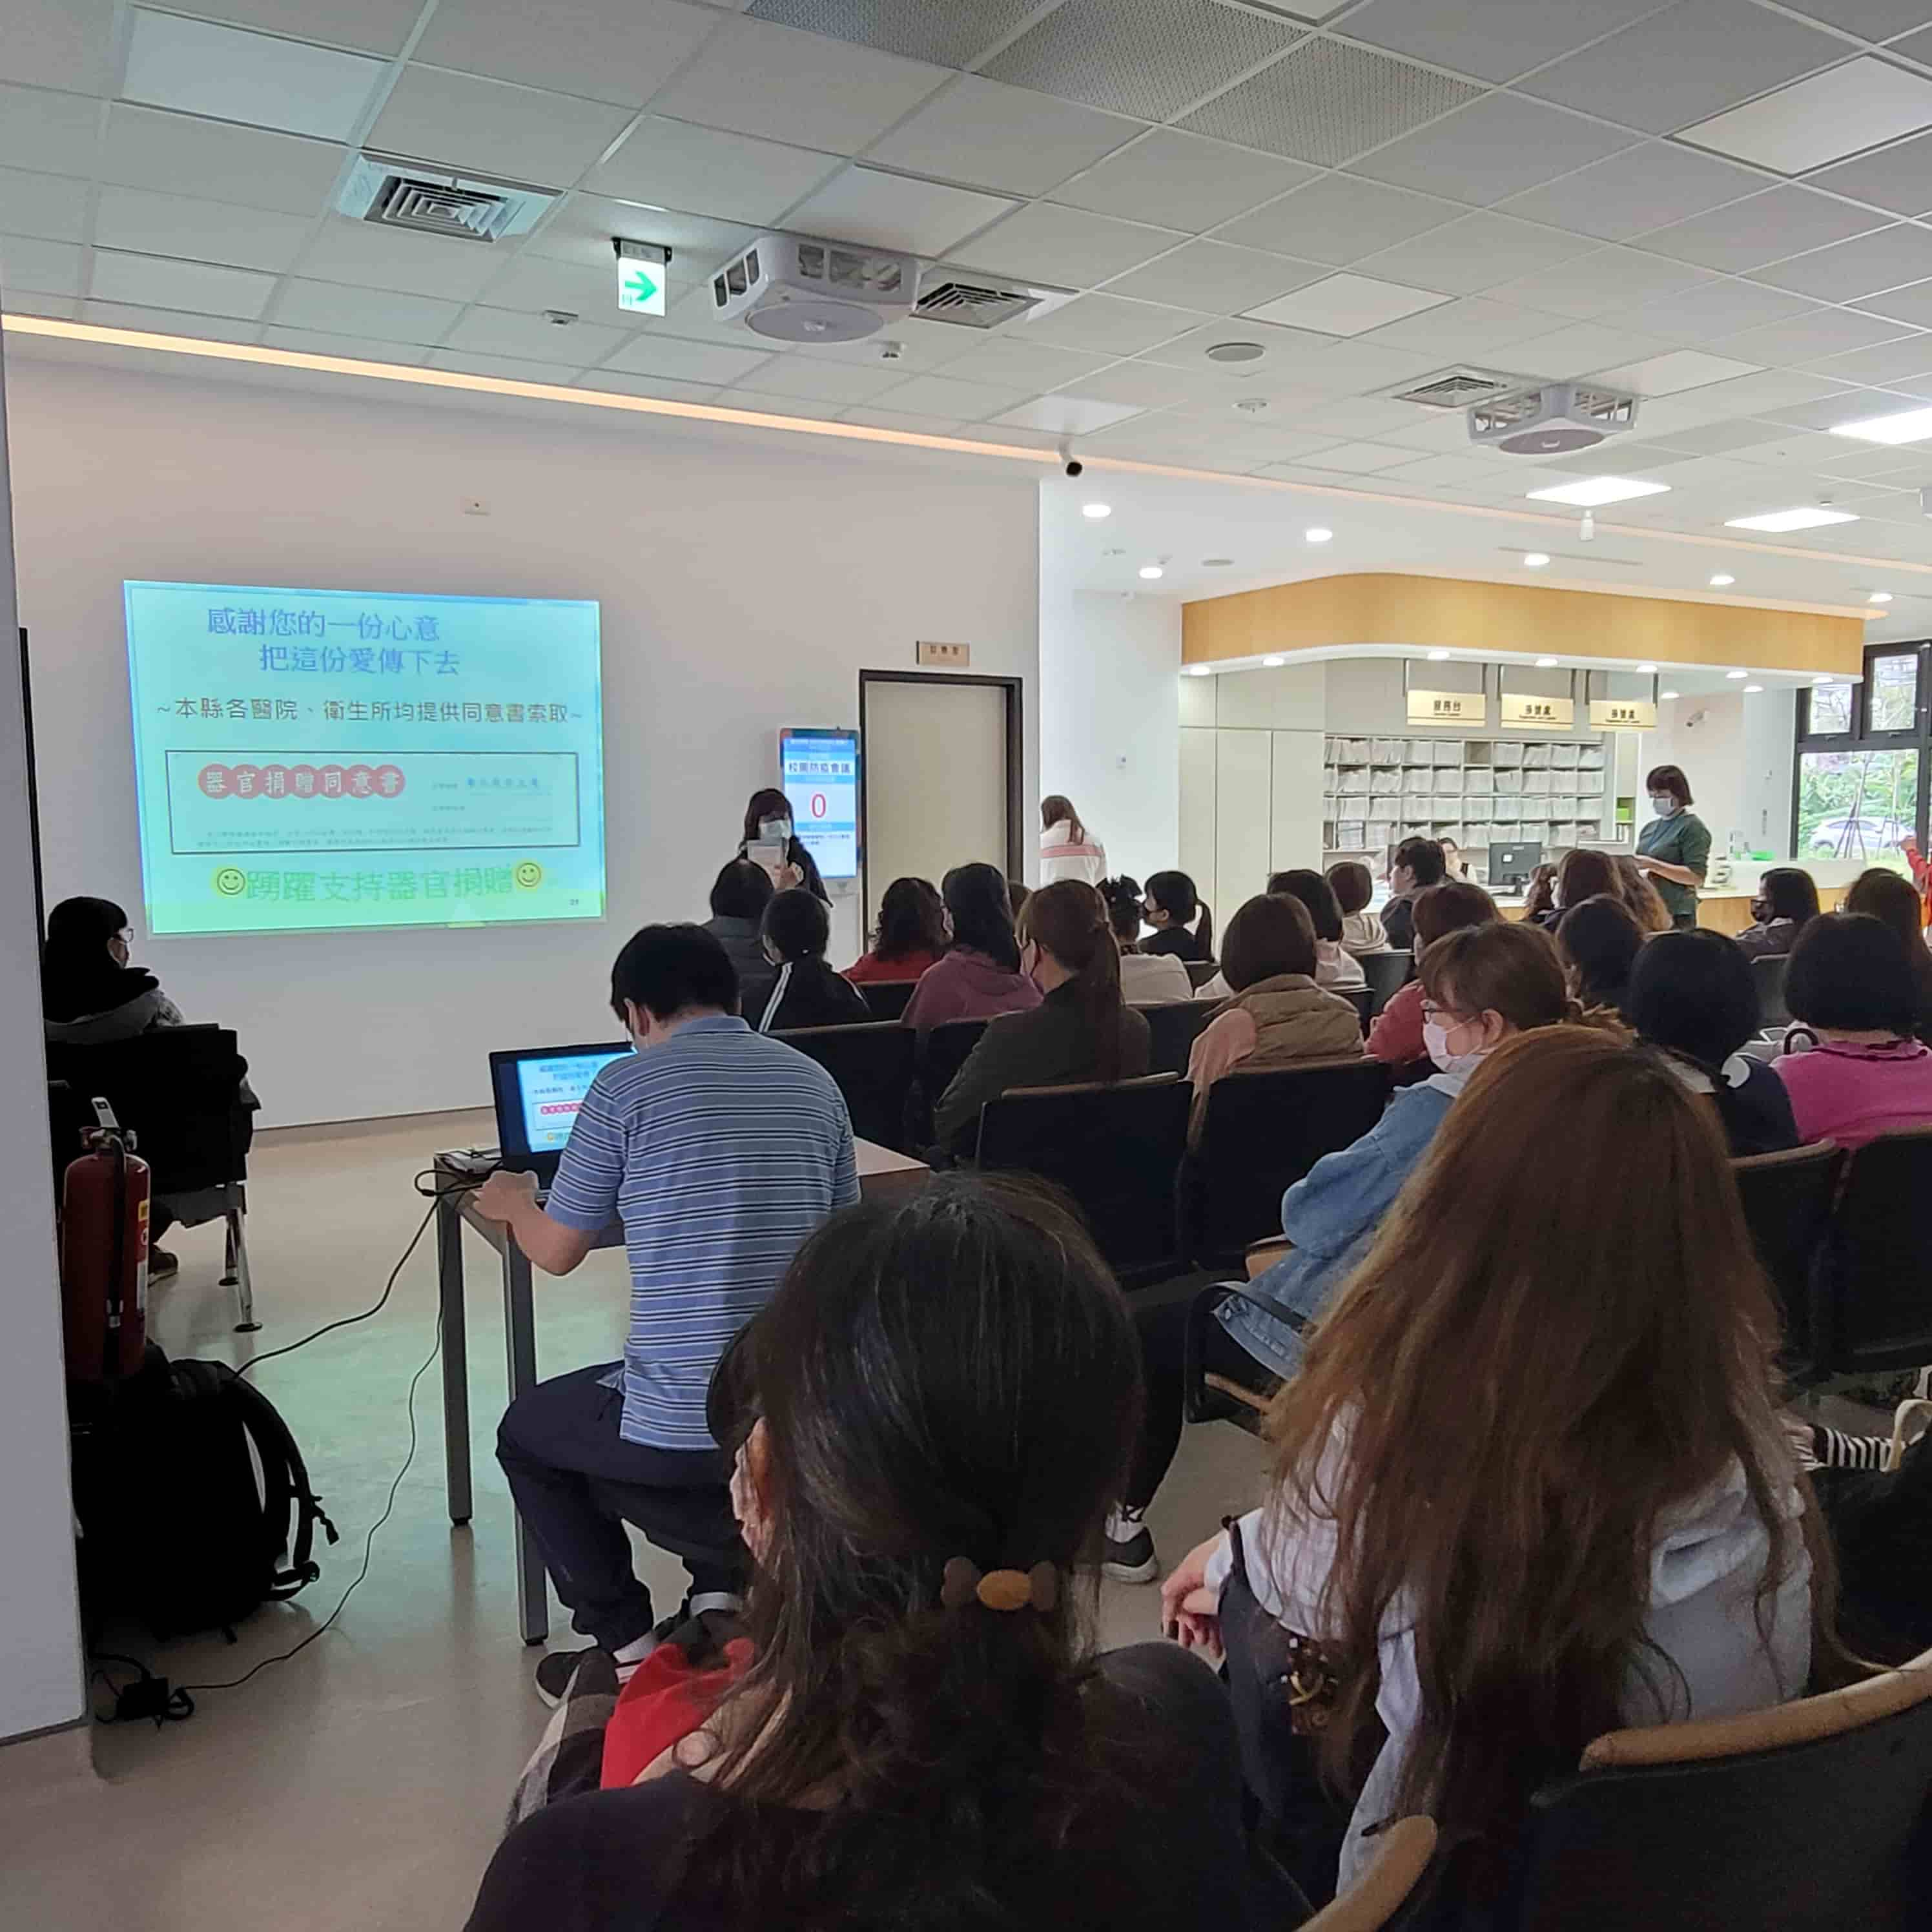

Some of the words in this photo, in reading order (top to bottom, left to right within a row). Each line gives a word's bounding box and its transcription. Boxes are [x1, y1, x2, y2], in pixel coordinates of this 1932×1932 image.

[207, 608, 440, 641] 感謝您的一份心意
[259, 644, 460, 676] 把這份愛傳下去
[206, 770, 400, 795] 器官捐贈同意書
[812, 794, 827, 818] 0
[247, 863, 513, 903] 踴躍支持器官捐贈
